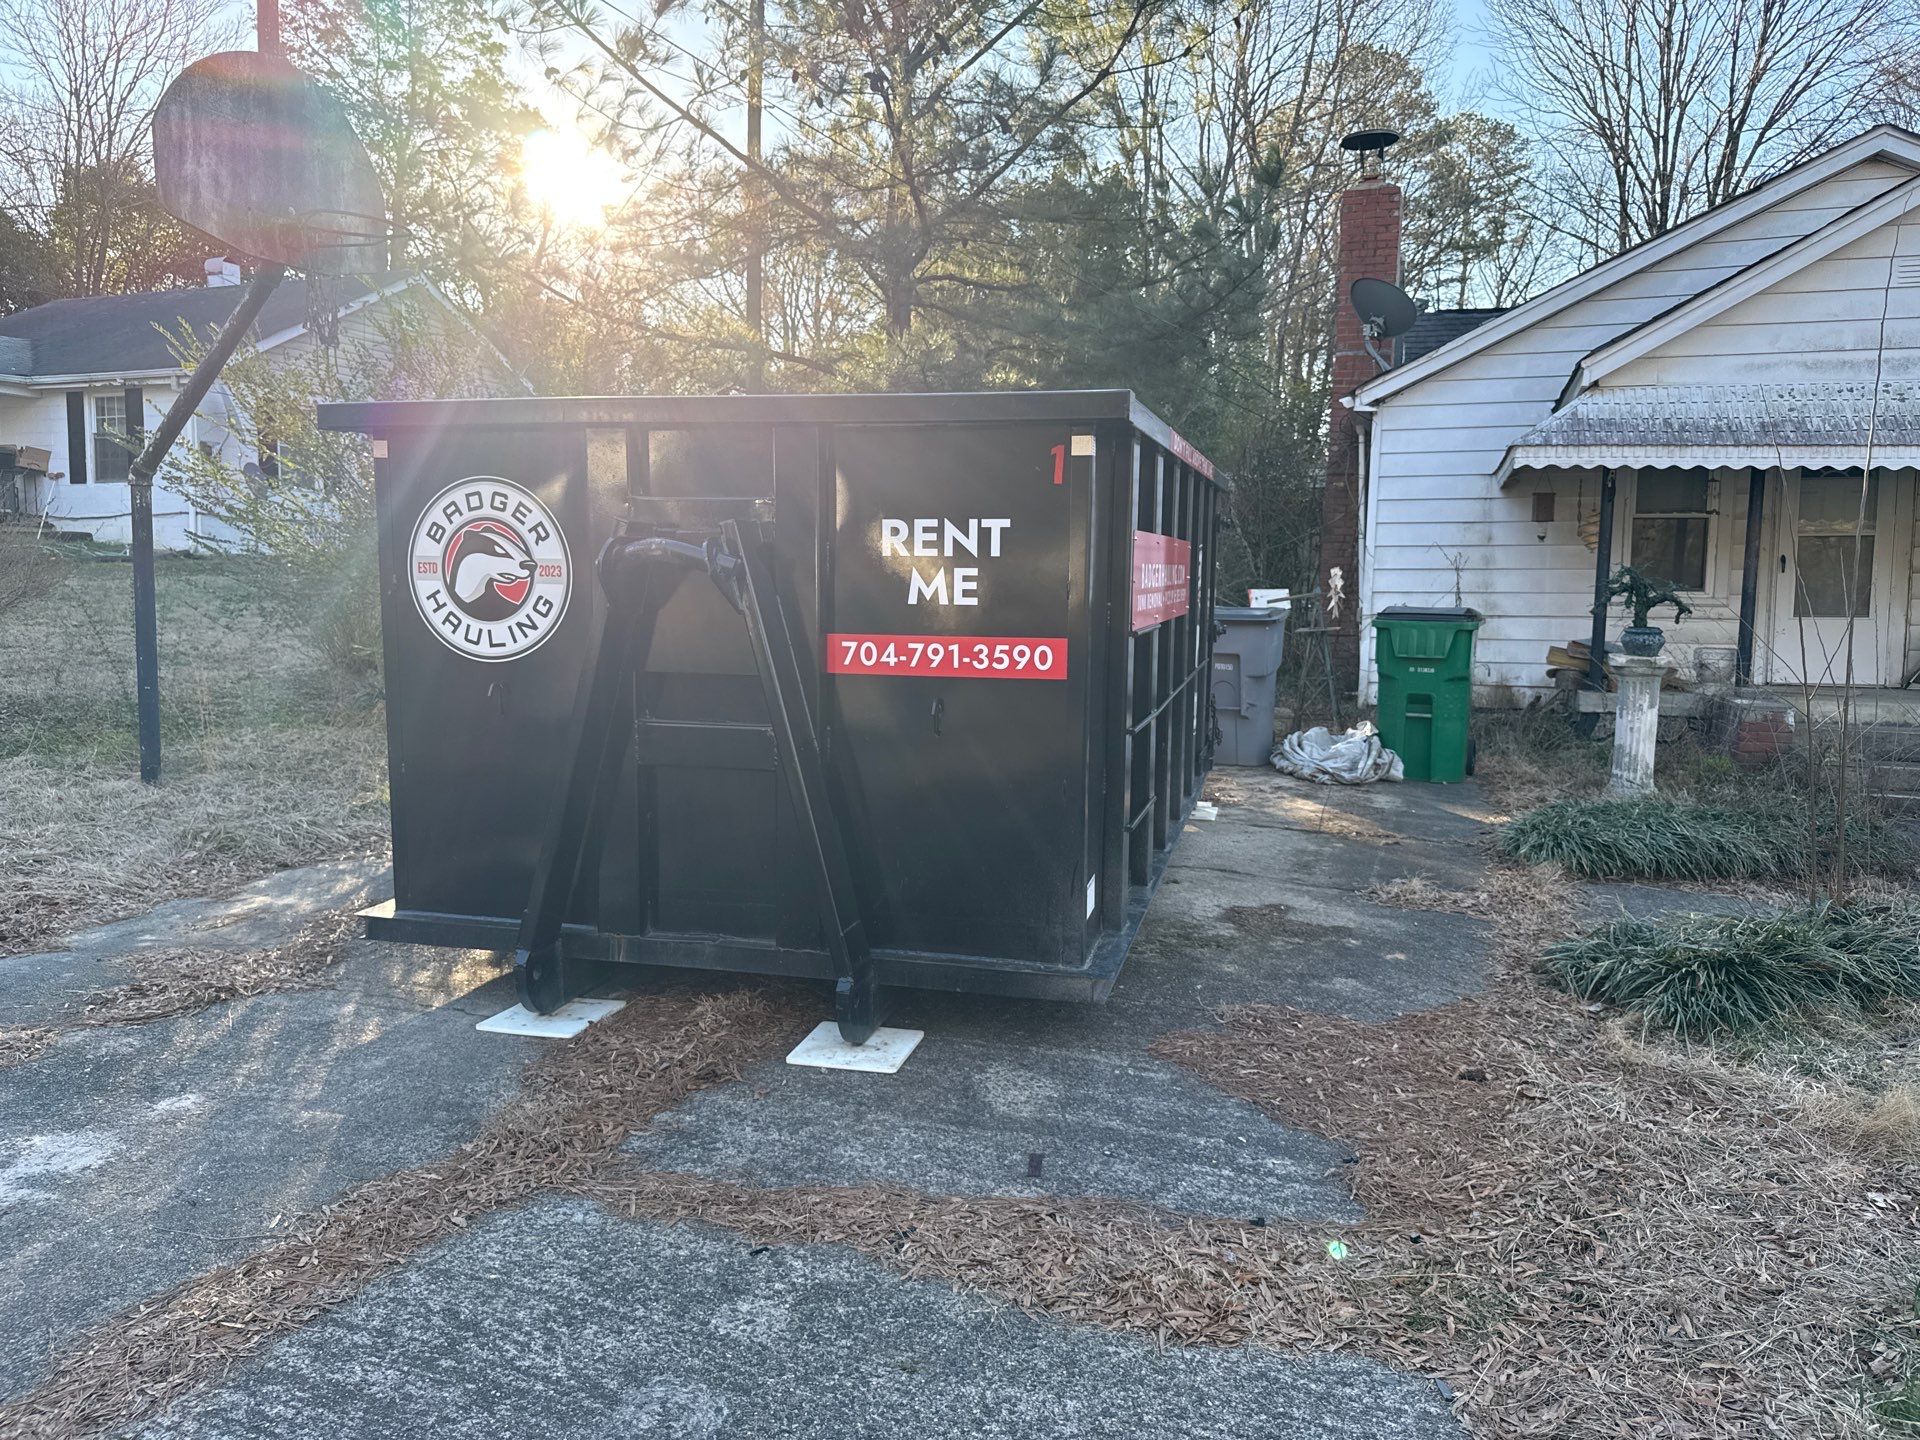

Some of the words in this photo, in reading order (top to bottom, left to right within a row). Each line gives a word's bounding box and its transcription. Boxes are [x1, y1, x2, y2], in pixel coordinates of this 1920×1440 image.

[1050, 444, 1065, 485] 1
[426, 491, 550, 546] BADGER
[881, 518, 1011, 558] RENT
[418, 562, 438, 574] ESTD
[539, 565, 562, 578] 2023
[908, 566, 979, 606] ME
[426, 589, 553, 648] HAULING
[841, 641, 1053, 671] 704-791-3590
